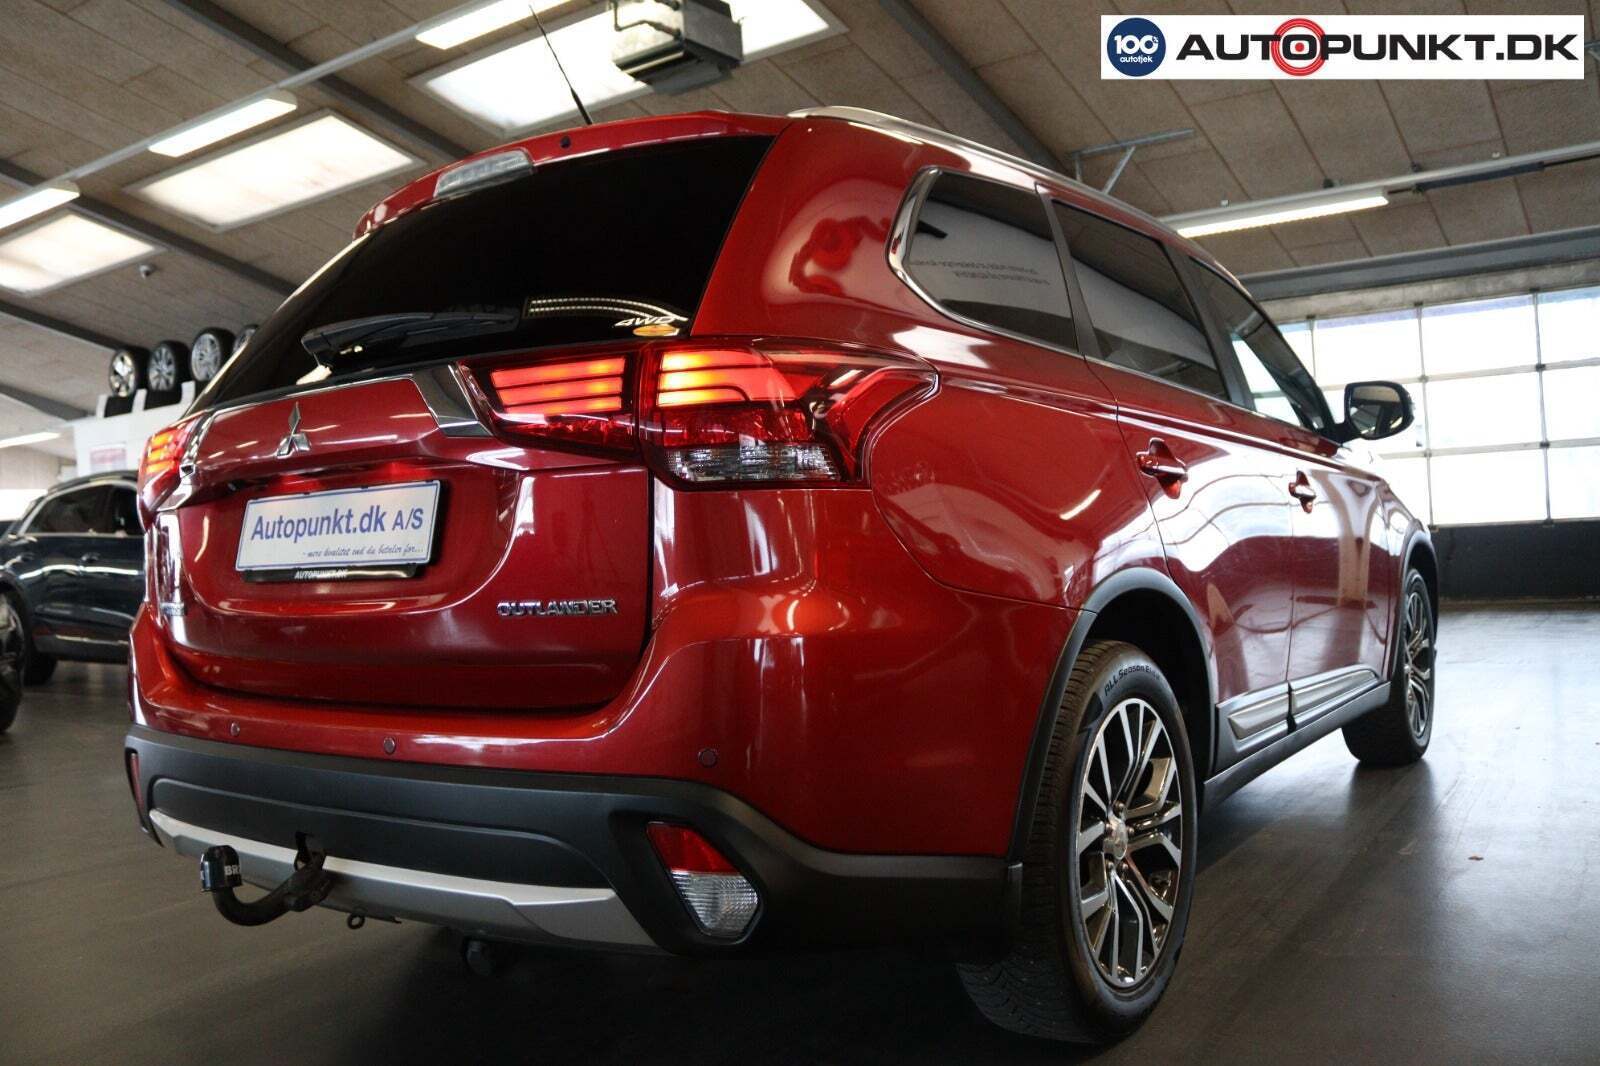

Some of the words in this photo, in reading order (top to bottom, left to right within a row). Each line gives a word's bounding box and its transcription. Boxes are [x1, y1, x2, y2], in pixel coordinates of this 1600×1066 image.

[251, 505, 387, 543] Autopunkt.dk
[392, 508, 424, 531] A/S
[497, 599, 618, 616] OUTLANDER
